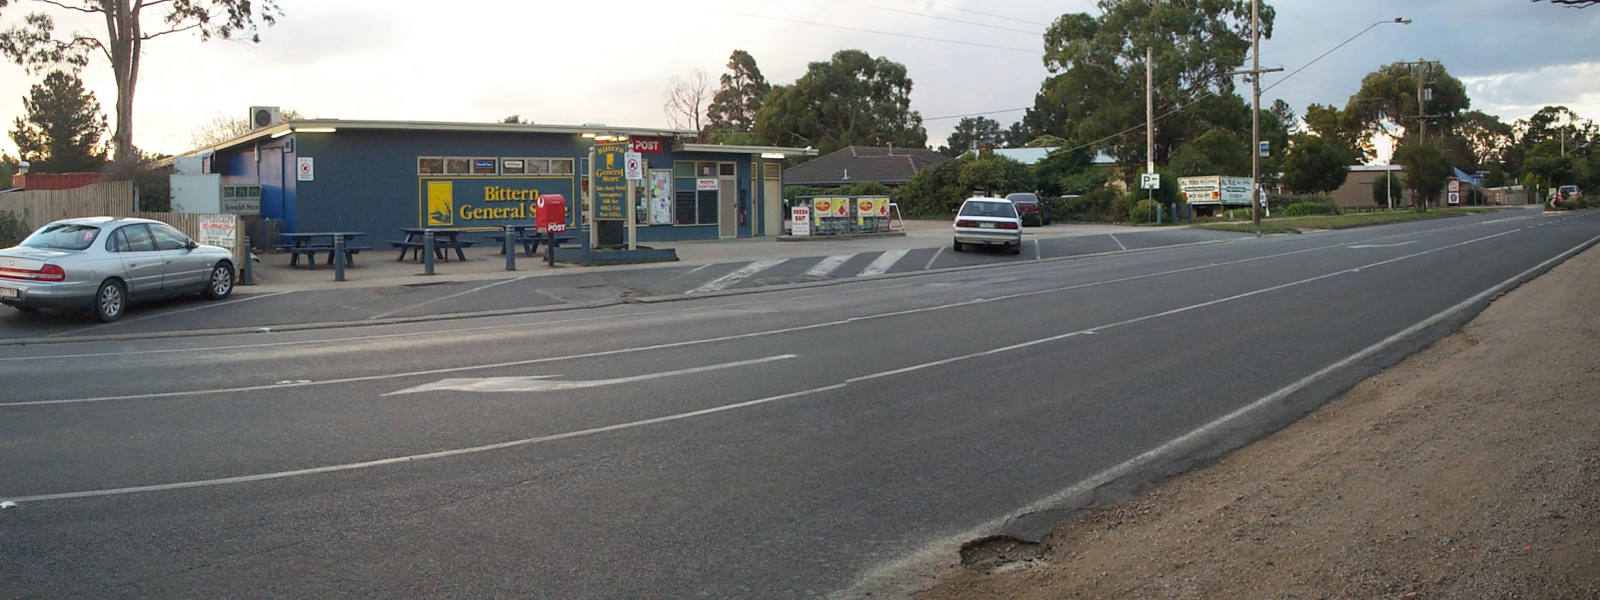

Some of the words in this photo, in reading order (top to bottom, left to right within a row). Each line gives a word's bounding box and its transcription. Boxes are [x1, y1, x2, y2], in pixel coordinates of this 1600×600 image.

[635, 140, 659, 150] POST
[597, 146, 624, 155] Bittern
[595, 168, 624, 177] General
[1143, 175, 1151, 188] P
[484, 186, 540, 202] Bittern
[459, 202, 526, 220] General
[548, 224, 566, 232] POST
